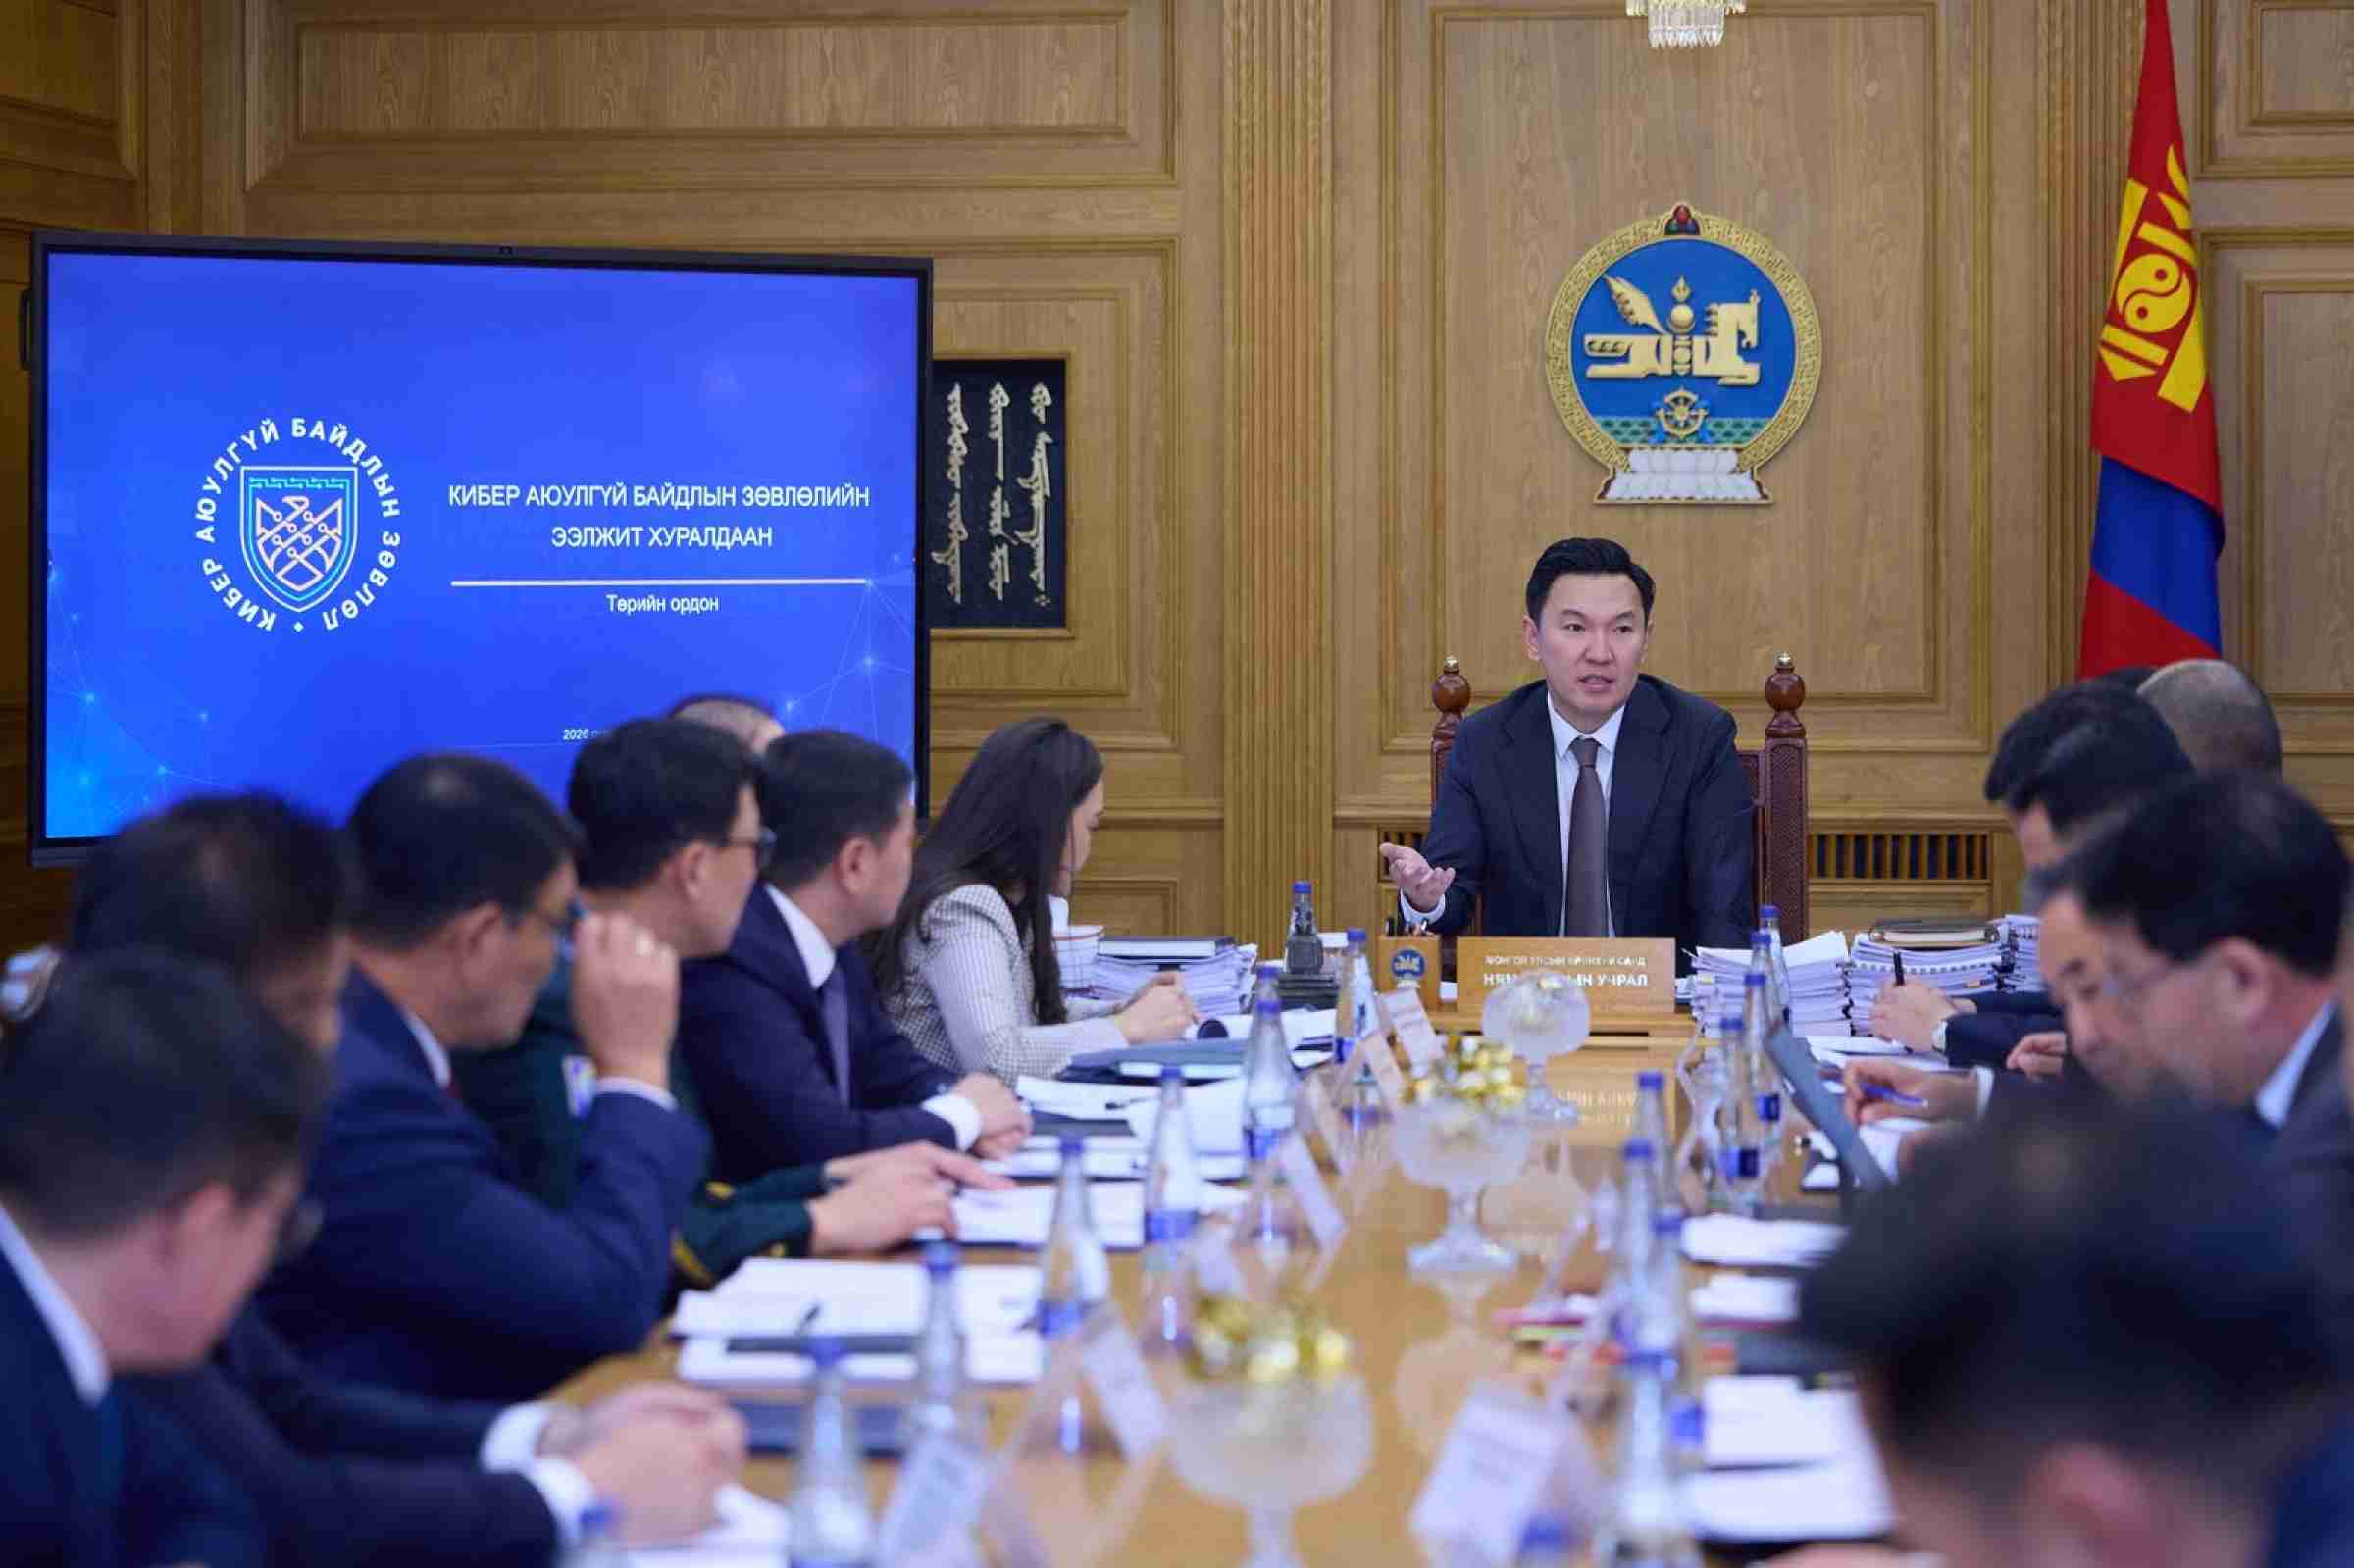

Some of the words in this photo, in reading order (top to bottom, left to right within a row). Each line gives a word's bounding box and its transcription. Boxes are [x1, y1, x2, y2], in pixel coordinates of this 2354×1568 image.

[196, 418, 280, 543] АЮУЛГҮЙ
[291, 418, 401, 517] БАЙДЛЫН
[448, 484, 520, 506] КИБЕР
[526, 481, 627, 506] АЮУЛГҮЙ
[634, 482, 736, 510] БАЙДЛЫН
[742, 482, 870, 507] ЗӨВЛӨЛИЙН
[551, 527, 643, 547] ЭЭЛЖИТ
[648, 527, 773, 550] ХУРАЛДААН
[202, 558, 276, 631] КИБЕР
[322, 531, 401, 631] ЗӨВЛӨЛ
[606, 594, 666, 615] Төрийн
[671, 596, 719, 615] ордон
[563, 729, 589, 740] 2026
[1598, 972, 1648, 987] УЧРАЛ
